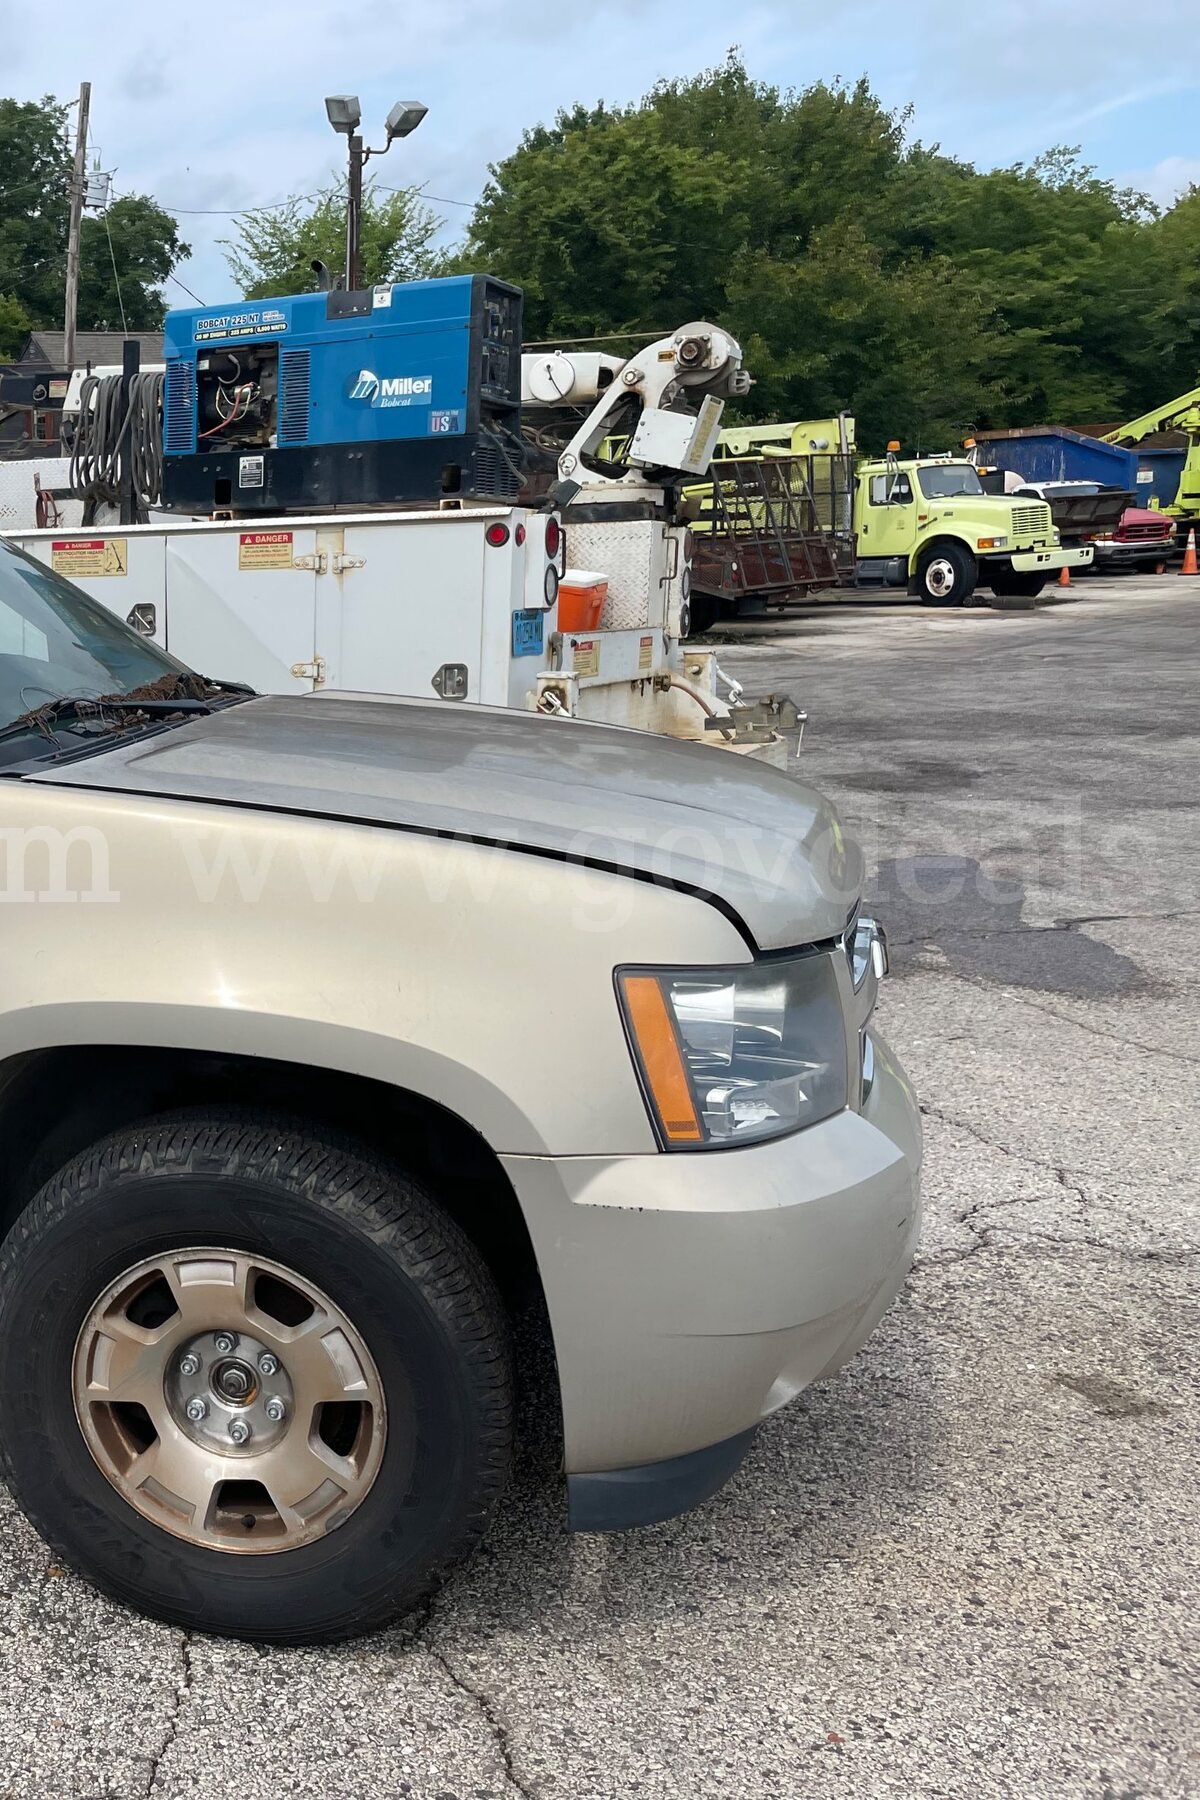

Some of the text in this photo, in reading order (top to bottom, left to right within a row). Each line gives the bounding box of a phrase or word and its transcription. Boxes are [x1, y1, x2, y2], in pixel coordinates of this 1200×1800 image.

[198, 313, 259, 330] BOBCAT 225 NT
[381, 378, 431, 396] Miller
[380, 398, 411, 408] Bobcat
[431, 416, 459, 433] USA
[255, 534, 289, 543] DANGER
